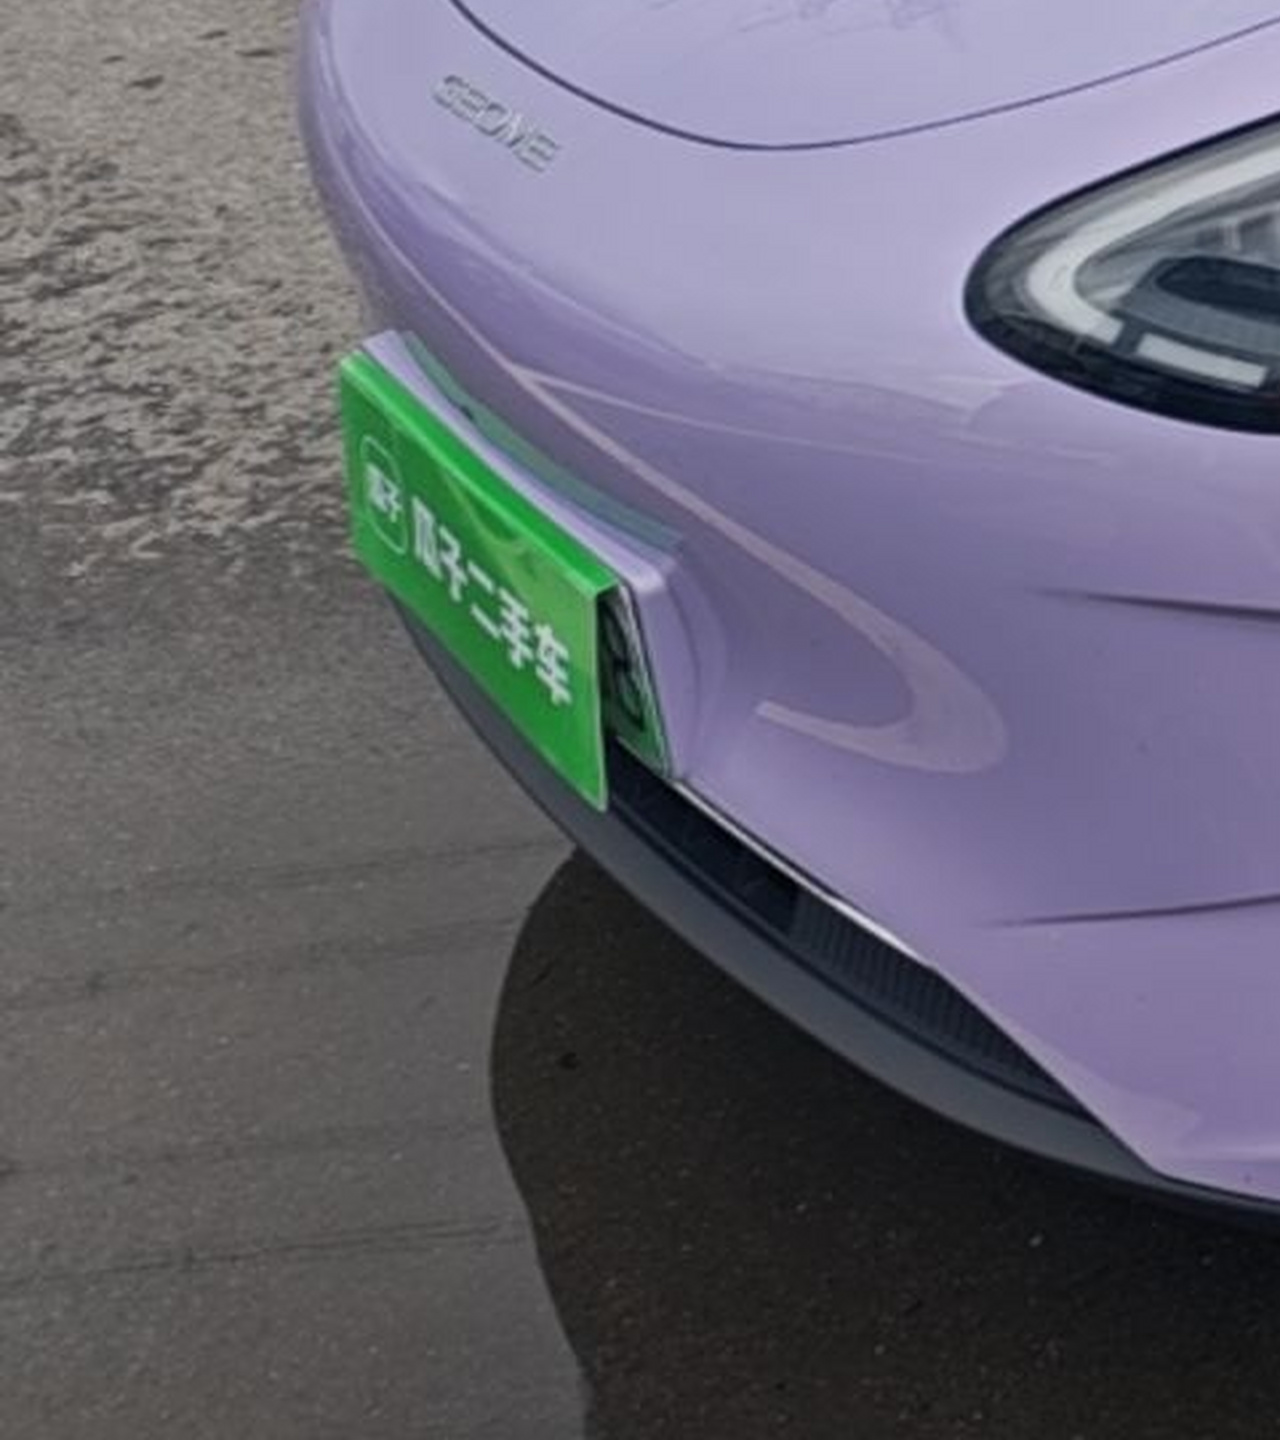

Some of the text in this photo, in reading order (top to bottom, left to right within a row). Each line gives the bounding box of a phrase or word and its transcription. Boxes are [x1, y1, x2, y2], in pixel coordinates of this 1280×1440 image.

[411, 494, 573, 708] 瓜子二手车
